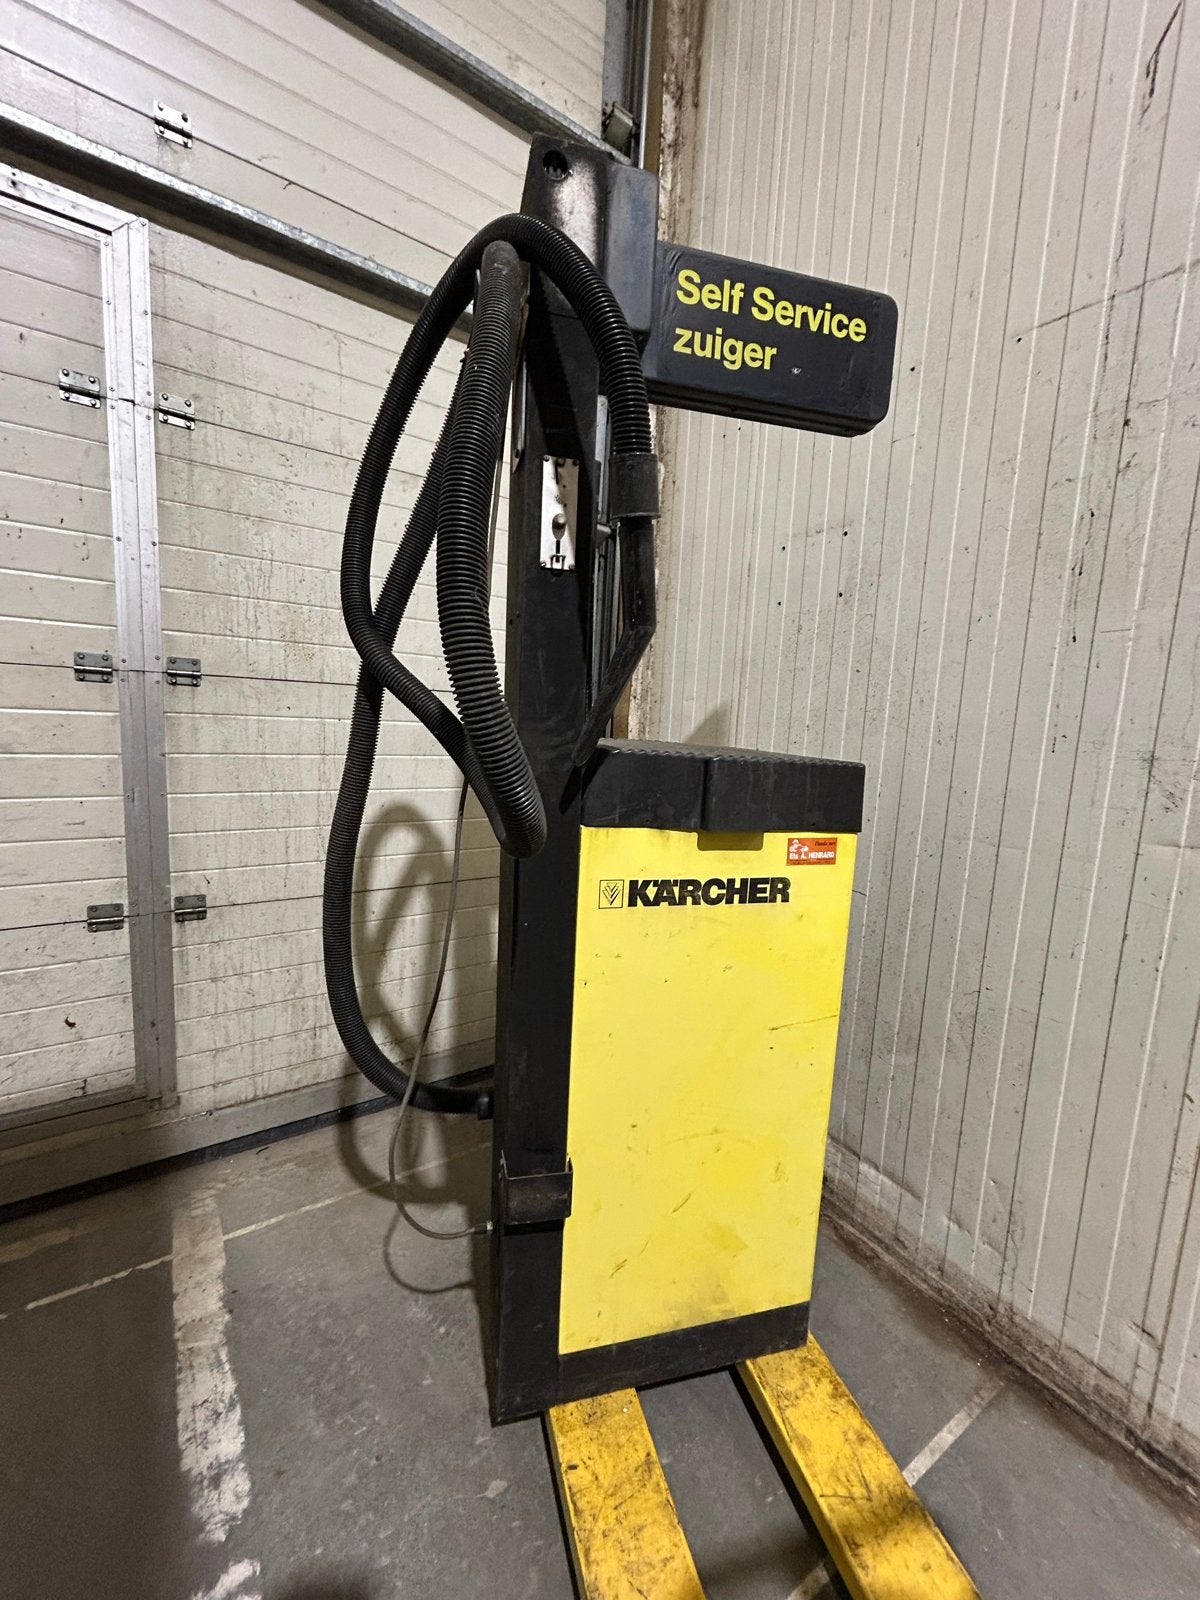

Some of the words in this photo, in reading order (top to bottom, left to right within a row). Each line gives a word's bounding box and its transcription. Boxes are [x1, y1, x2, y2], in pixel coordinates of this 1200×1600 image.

[676, 269, 745, 315] Self
[751, 286, 867, 342] Service
[673, 327, 777, 370] zuiger
[627, 876, 791, 907] KÄRCHER
